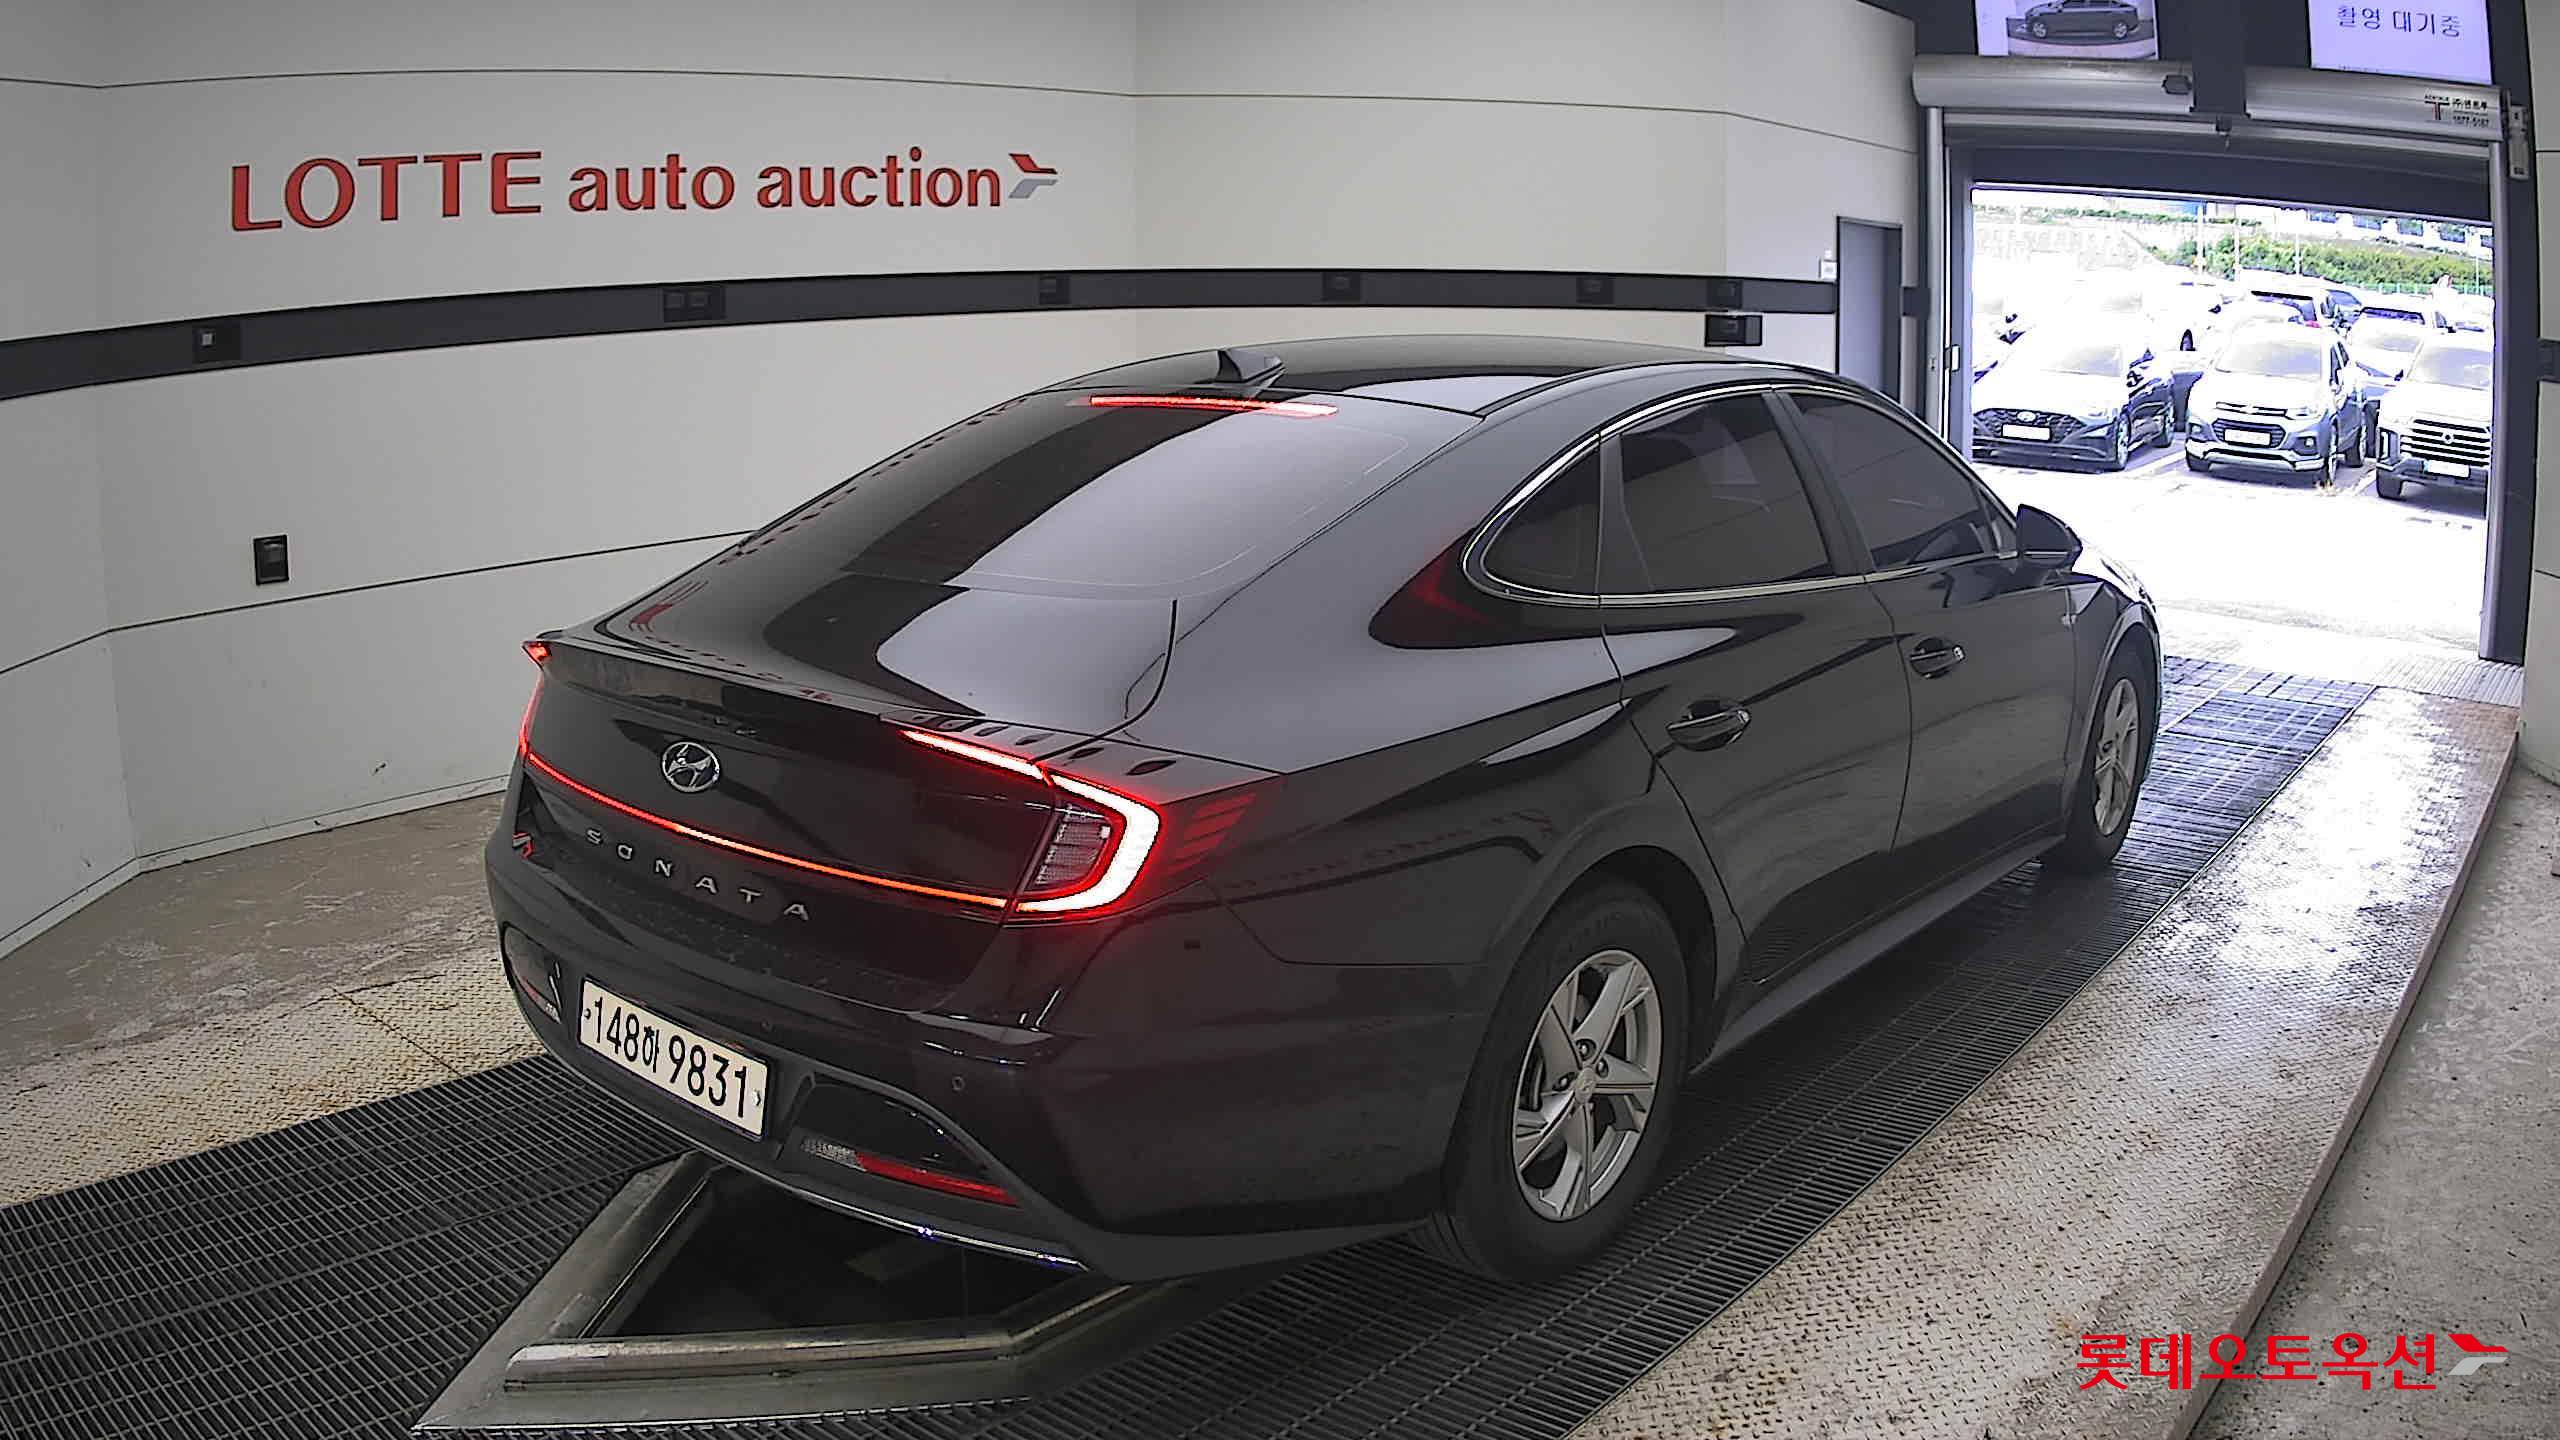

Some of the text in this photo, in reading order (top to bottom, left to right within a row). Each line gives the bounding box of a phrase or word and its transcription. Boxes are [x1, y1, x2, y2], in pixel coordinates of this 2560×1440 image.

[2337, 5, 2461, 38] 촬영 대기중
[231, 146, 1002, 232] LOTTE auto auction
[585, 827, 810, 921] SONATA
